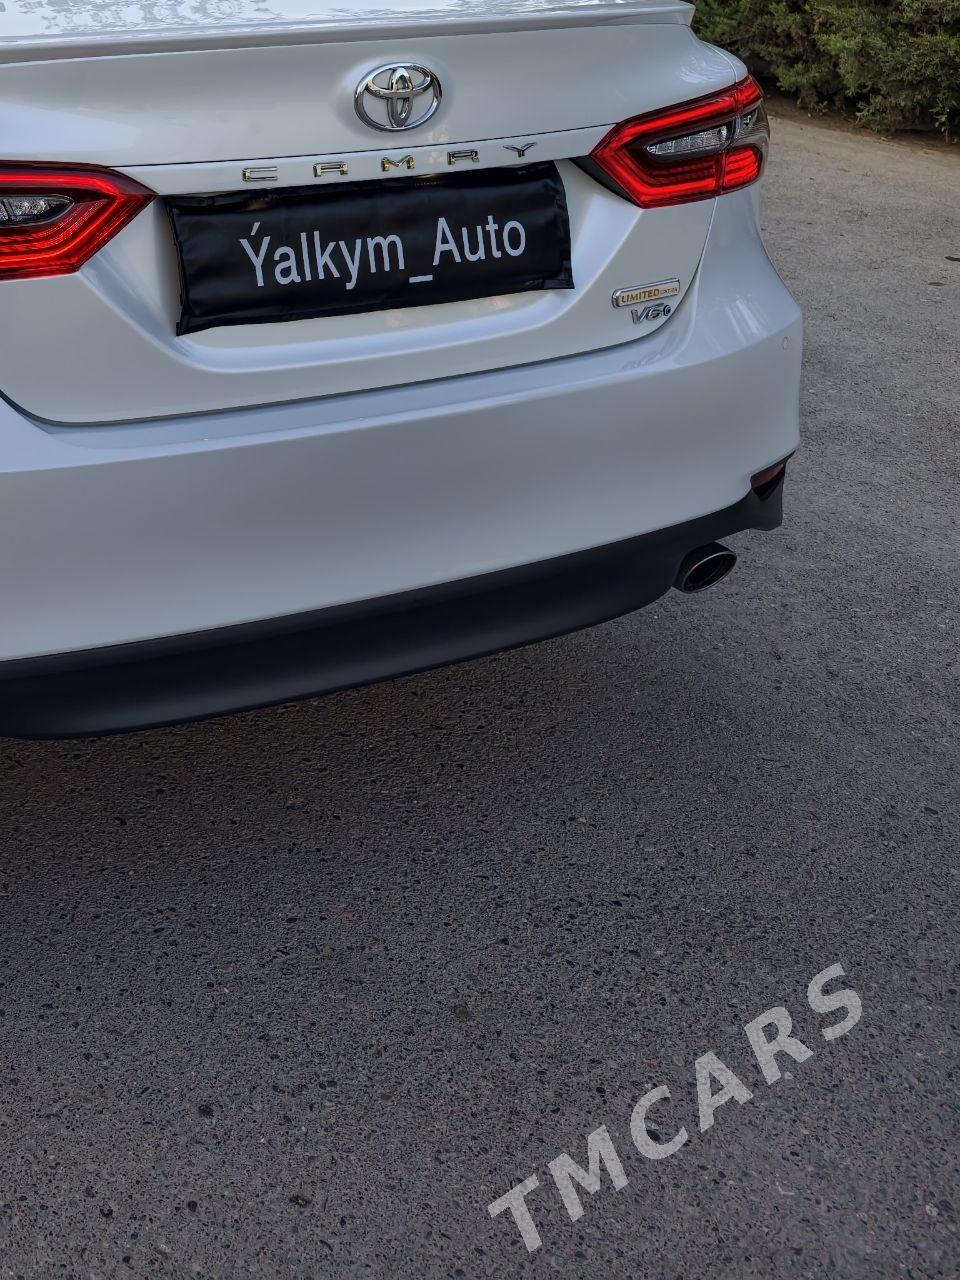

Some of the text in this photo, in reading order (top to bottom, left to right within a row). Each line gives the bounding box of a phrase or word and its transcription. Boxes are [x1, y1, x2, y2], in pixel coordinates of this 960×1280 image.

[242, 141, 538, 182] CAMRY
[240, 214, 527, 290] Ýalkym_Auto
[621, 288, 660, 303] LIMITED
